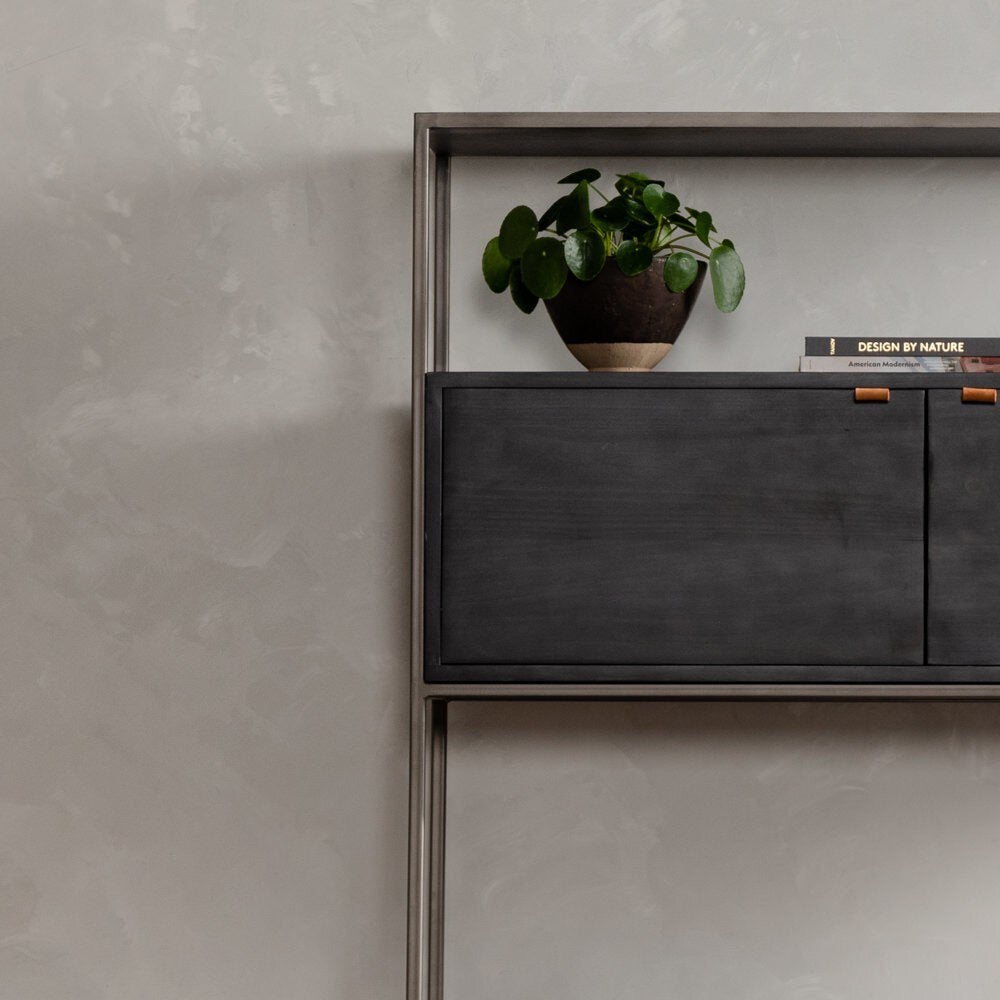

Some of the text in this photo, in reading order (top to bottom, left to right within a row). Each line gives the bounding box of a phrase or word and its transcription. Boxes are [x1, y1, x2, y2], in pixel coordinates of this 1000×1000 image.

[858, 341, 965, 352] DESIGN BY NATURE
